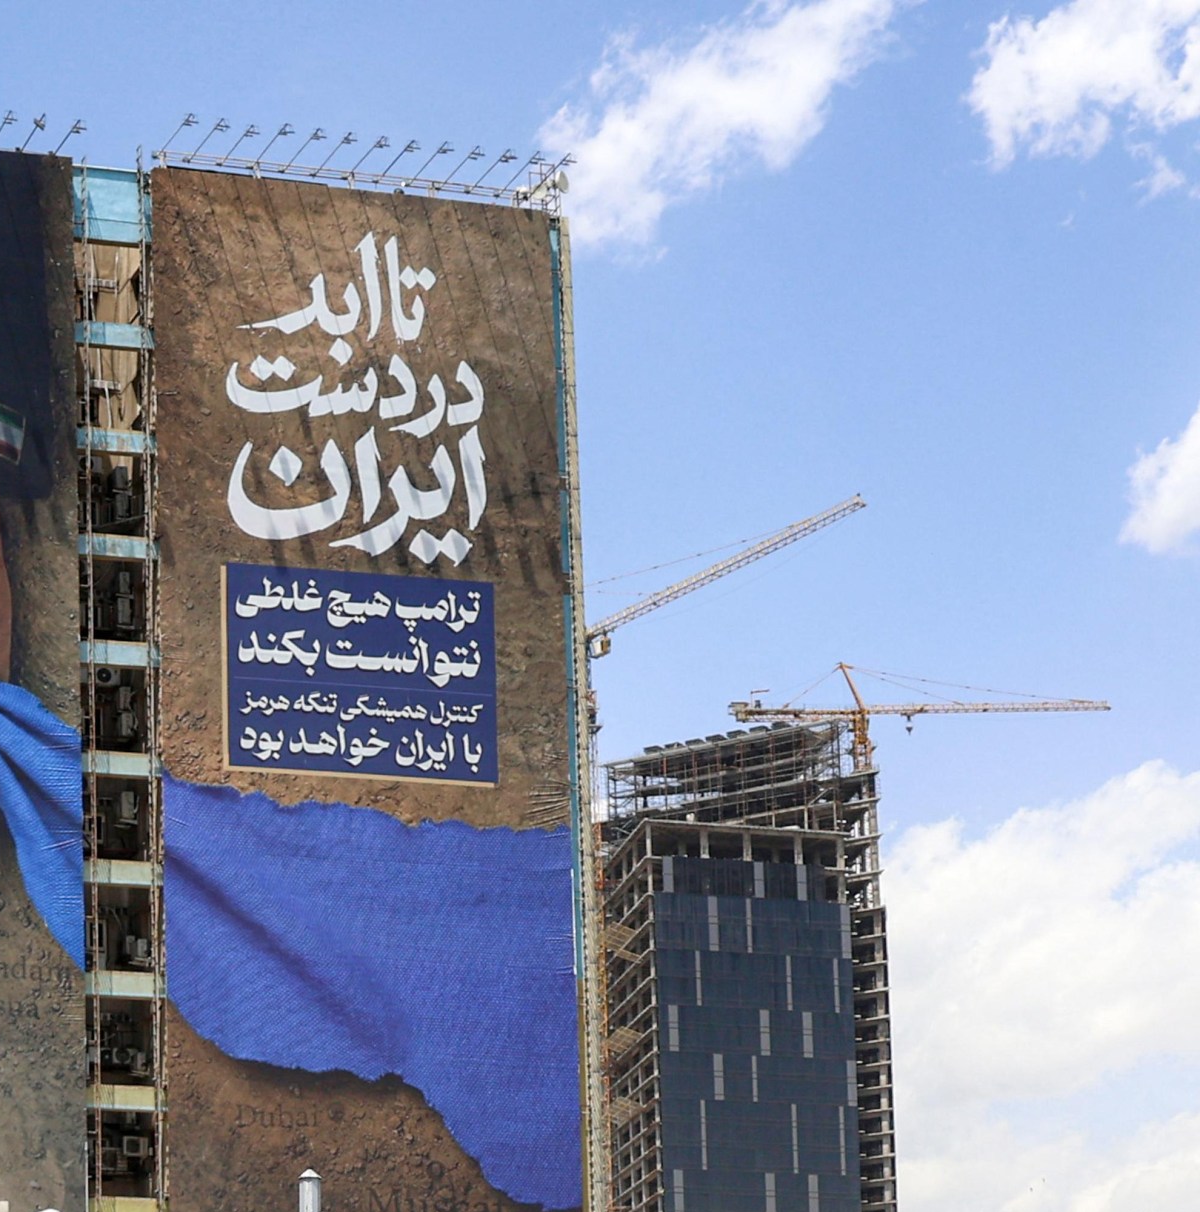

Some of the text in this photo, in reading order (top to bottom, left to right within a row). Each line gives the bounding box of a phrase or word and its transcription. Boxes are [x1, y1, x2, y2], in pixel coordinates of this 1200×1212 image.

[236, 231, 437, 366] تا ابد
[226, 354, 485, 438] در دست
[227, 425, 487, 567] ایران
[235, 577, 481, 632] ترامپ هیچ غلطی
[237, 629, 481, 687] نتوانست بکند
[239, 690, 483, 727] کنترل همیشگی تنگه هرمز
[239, 724, 482, 772] با ایران خواهد بود
[236, 1103, 319, 1129] Dubai
